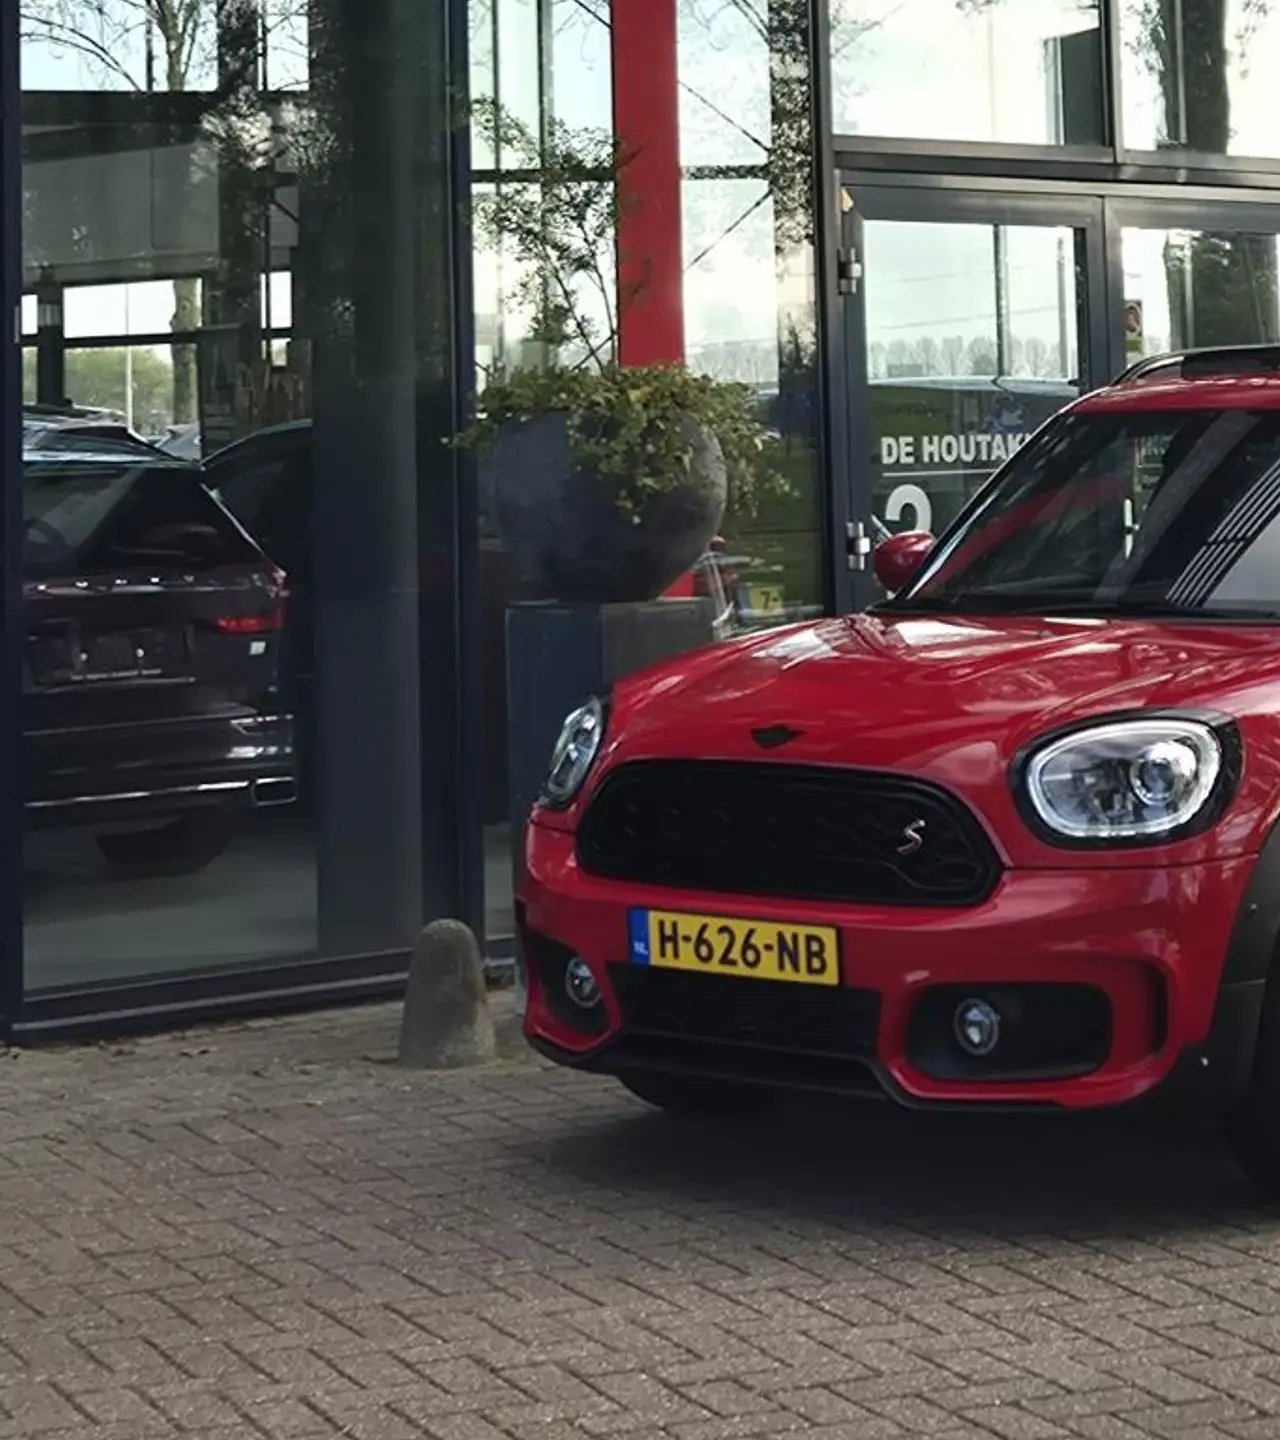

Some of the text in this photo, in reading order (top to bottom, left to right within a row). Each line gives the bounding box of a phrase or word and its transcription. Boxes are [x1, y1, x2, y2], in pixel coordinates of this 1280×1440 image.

[881, 432, 1032, 465] DE HOUTAK
[895, 818, 927, 855] S
[658, 918, 828, 977] H-626-NB
